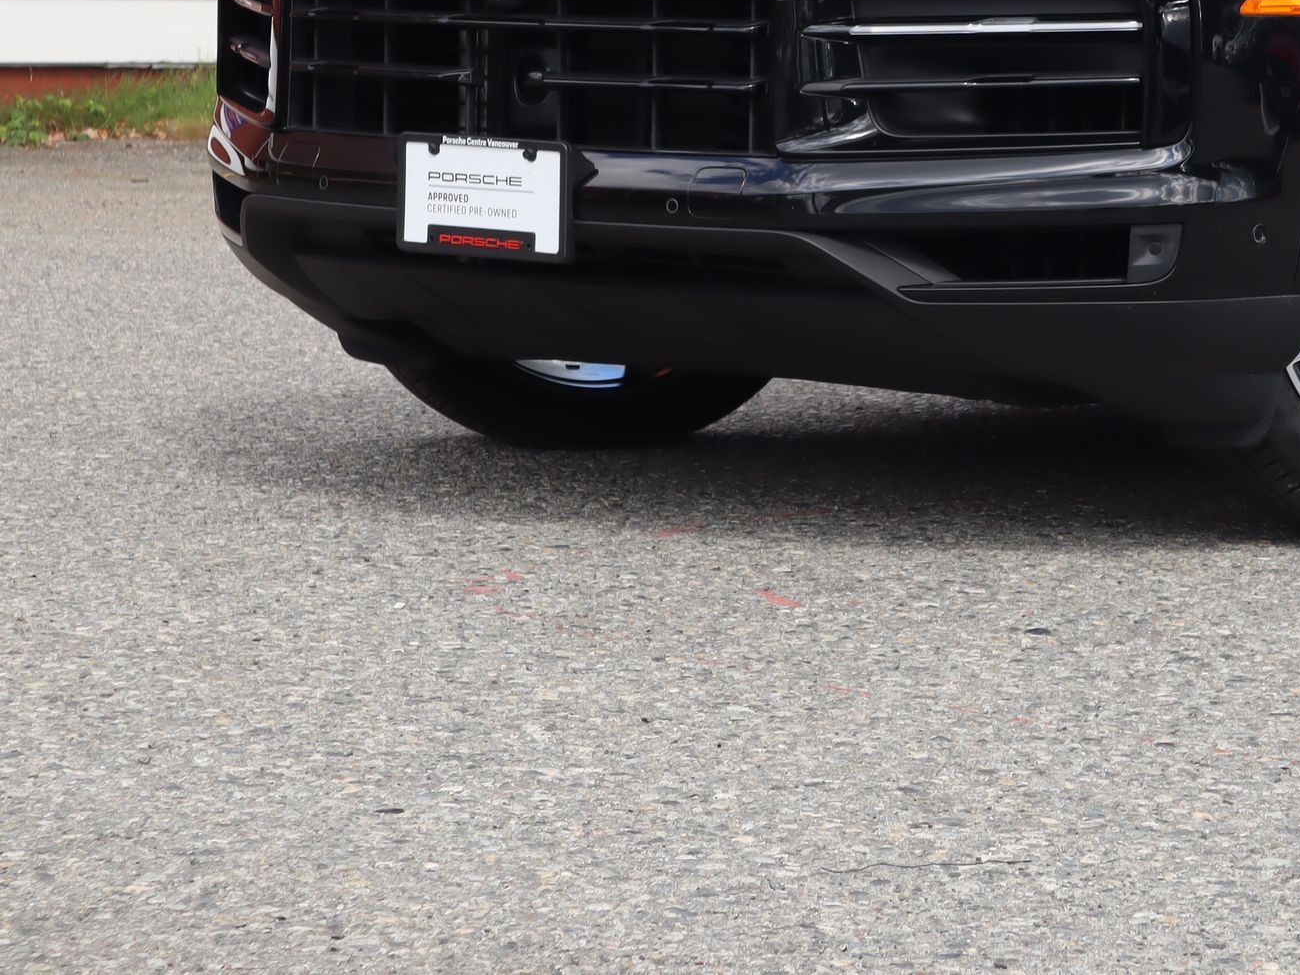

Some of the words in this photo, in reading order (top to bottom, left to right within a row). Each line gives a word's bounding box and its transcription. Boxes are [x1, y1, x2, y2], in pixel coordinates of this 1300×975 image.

[442, 135, 466, 145] Porsche
[466, 137, 486, 147] Centre
[487, 138, 519, 149] Vancouver
[428, 171, 522, 187] PORSCHE
[427, 192, 469, 204] APPROVED
[427, 203, 467, 215] CERTIFIED
[439, 234, 521, 250] PORSCHE
